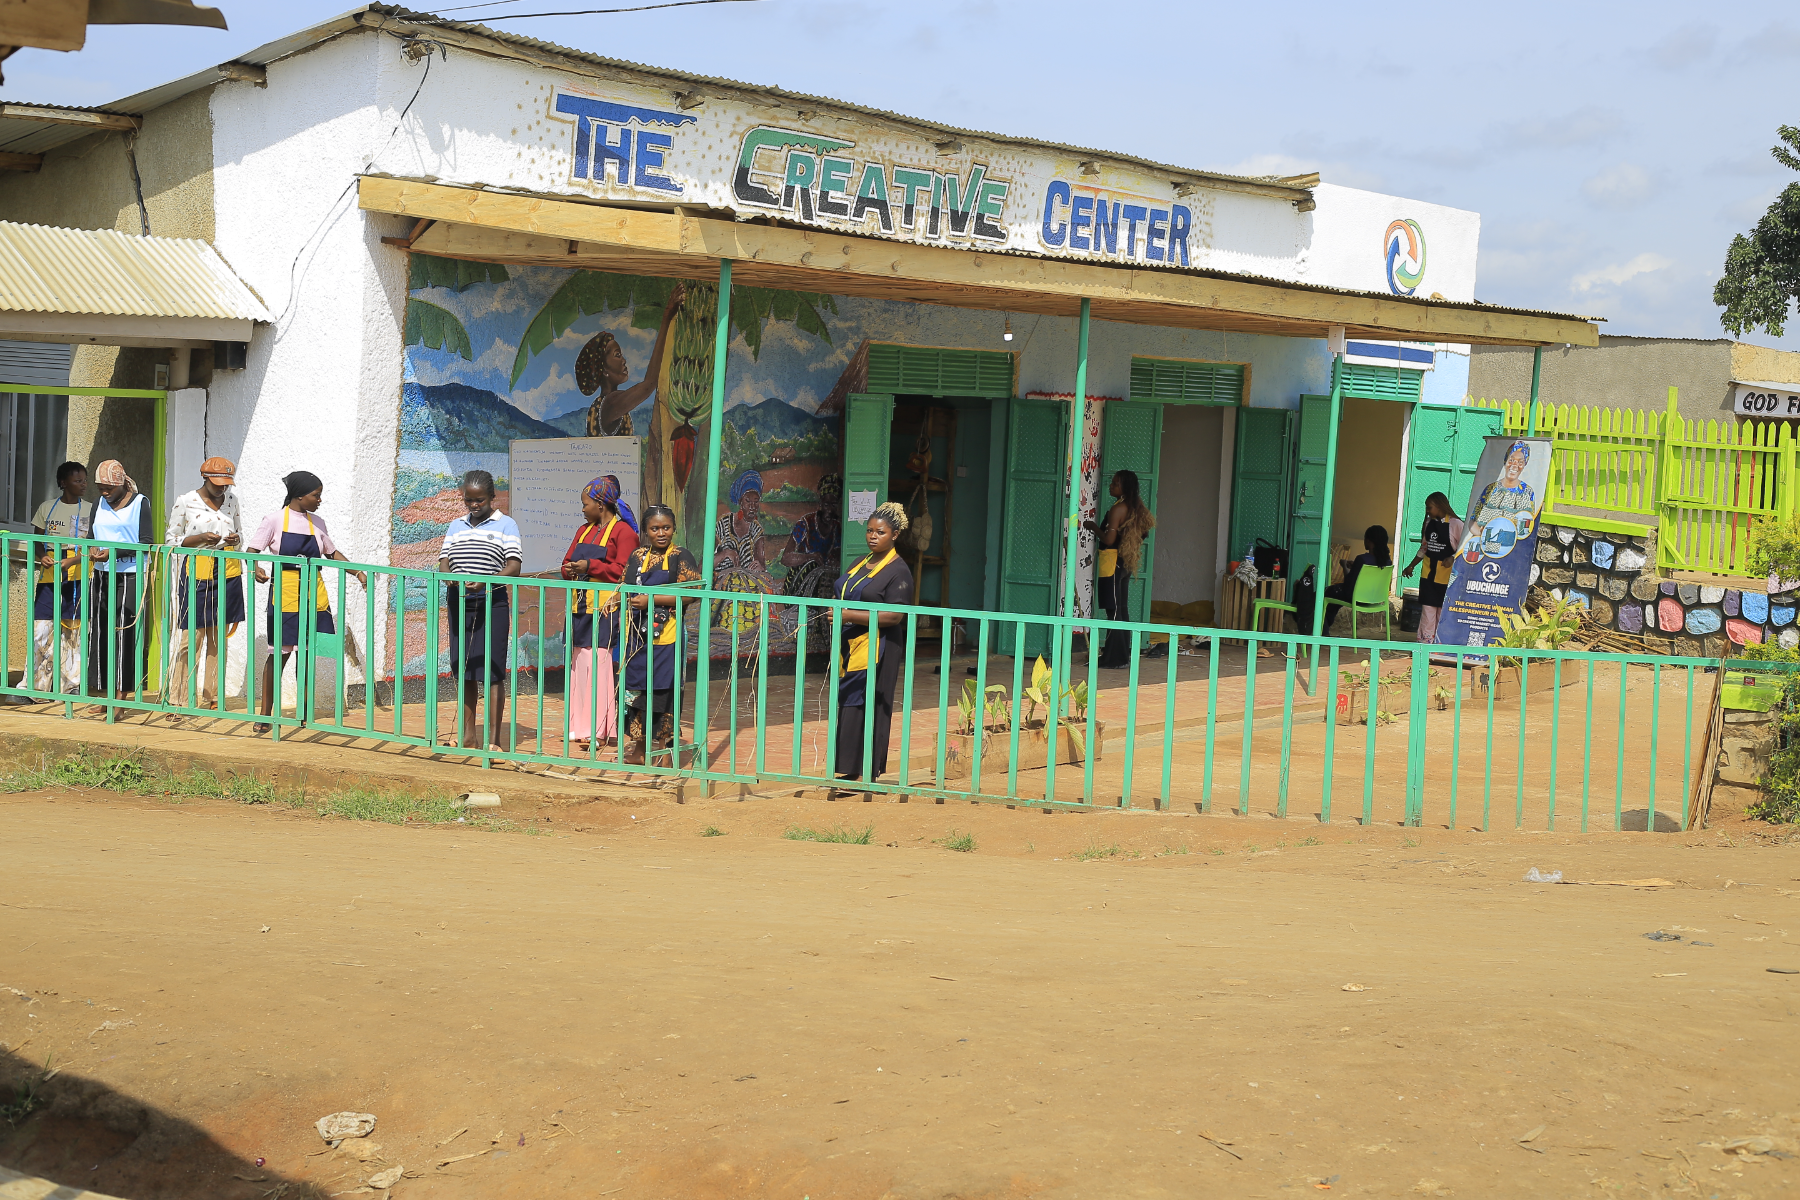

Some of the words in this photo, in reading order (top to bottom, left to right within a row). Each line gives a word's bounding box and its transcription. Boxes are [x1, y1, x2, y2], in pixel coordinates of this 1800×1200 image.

[555, 93, 698, 197] THE
[731, 124, 1010, 244] CREATIVE
[1040, 179, 1193, 268] CENTER
[1742, 391, 1779, 413] GOD
[1466, 580, 1510, 594] UBUCHANGE
[1448, 606, 1490, 616] SALESPRENEUR
